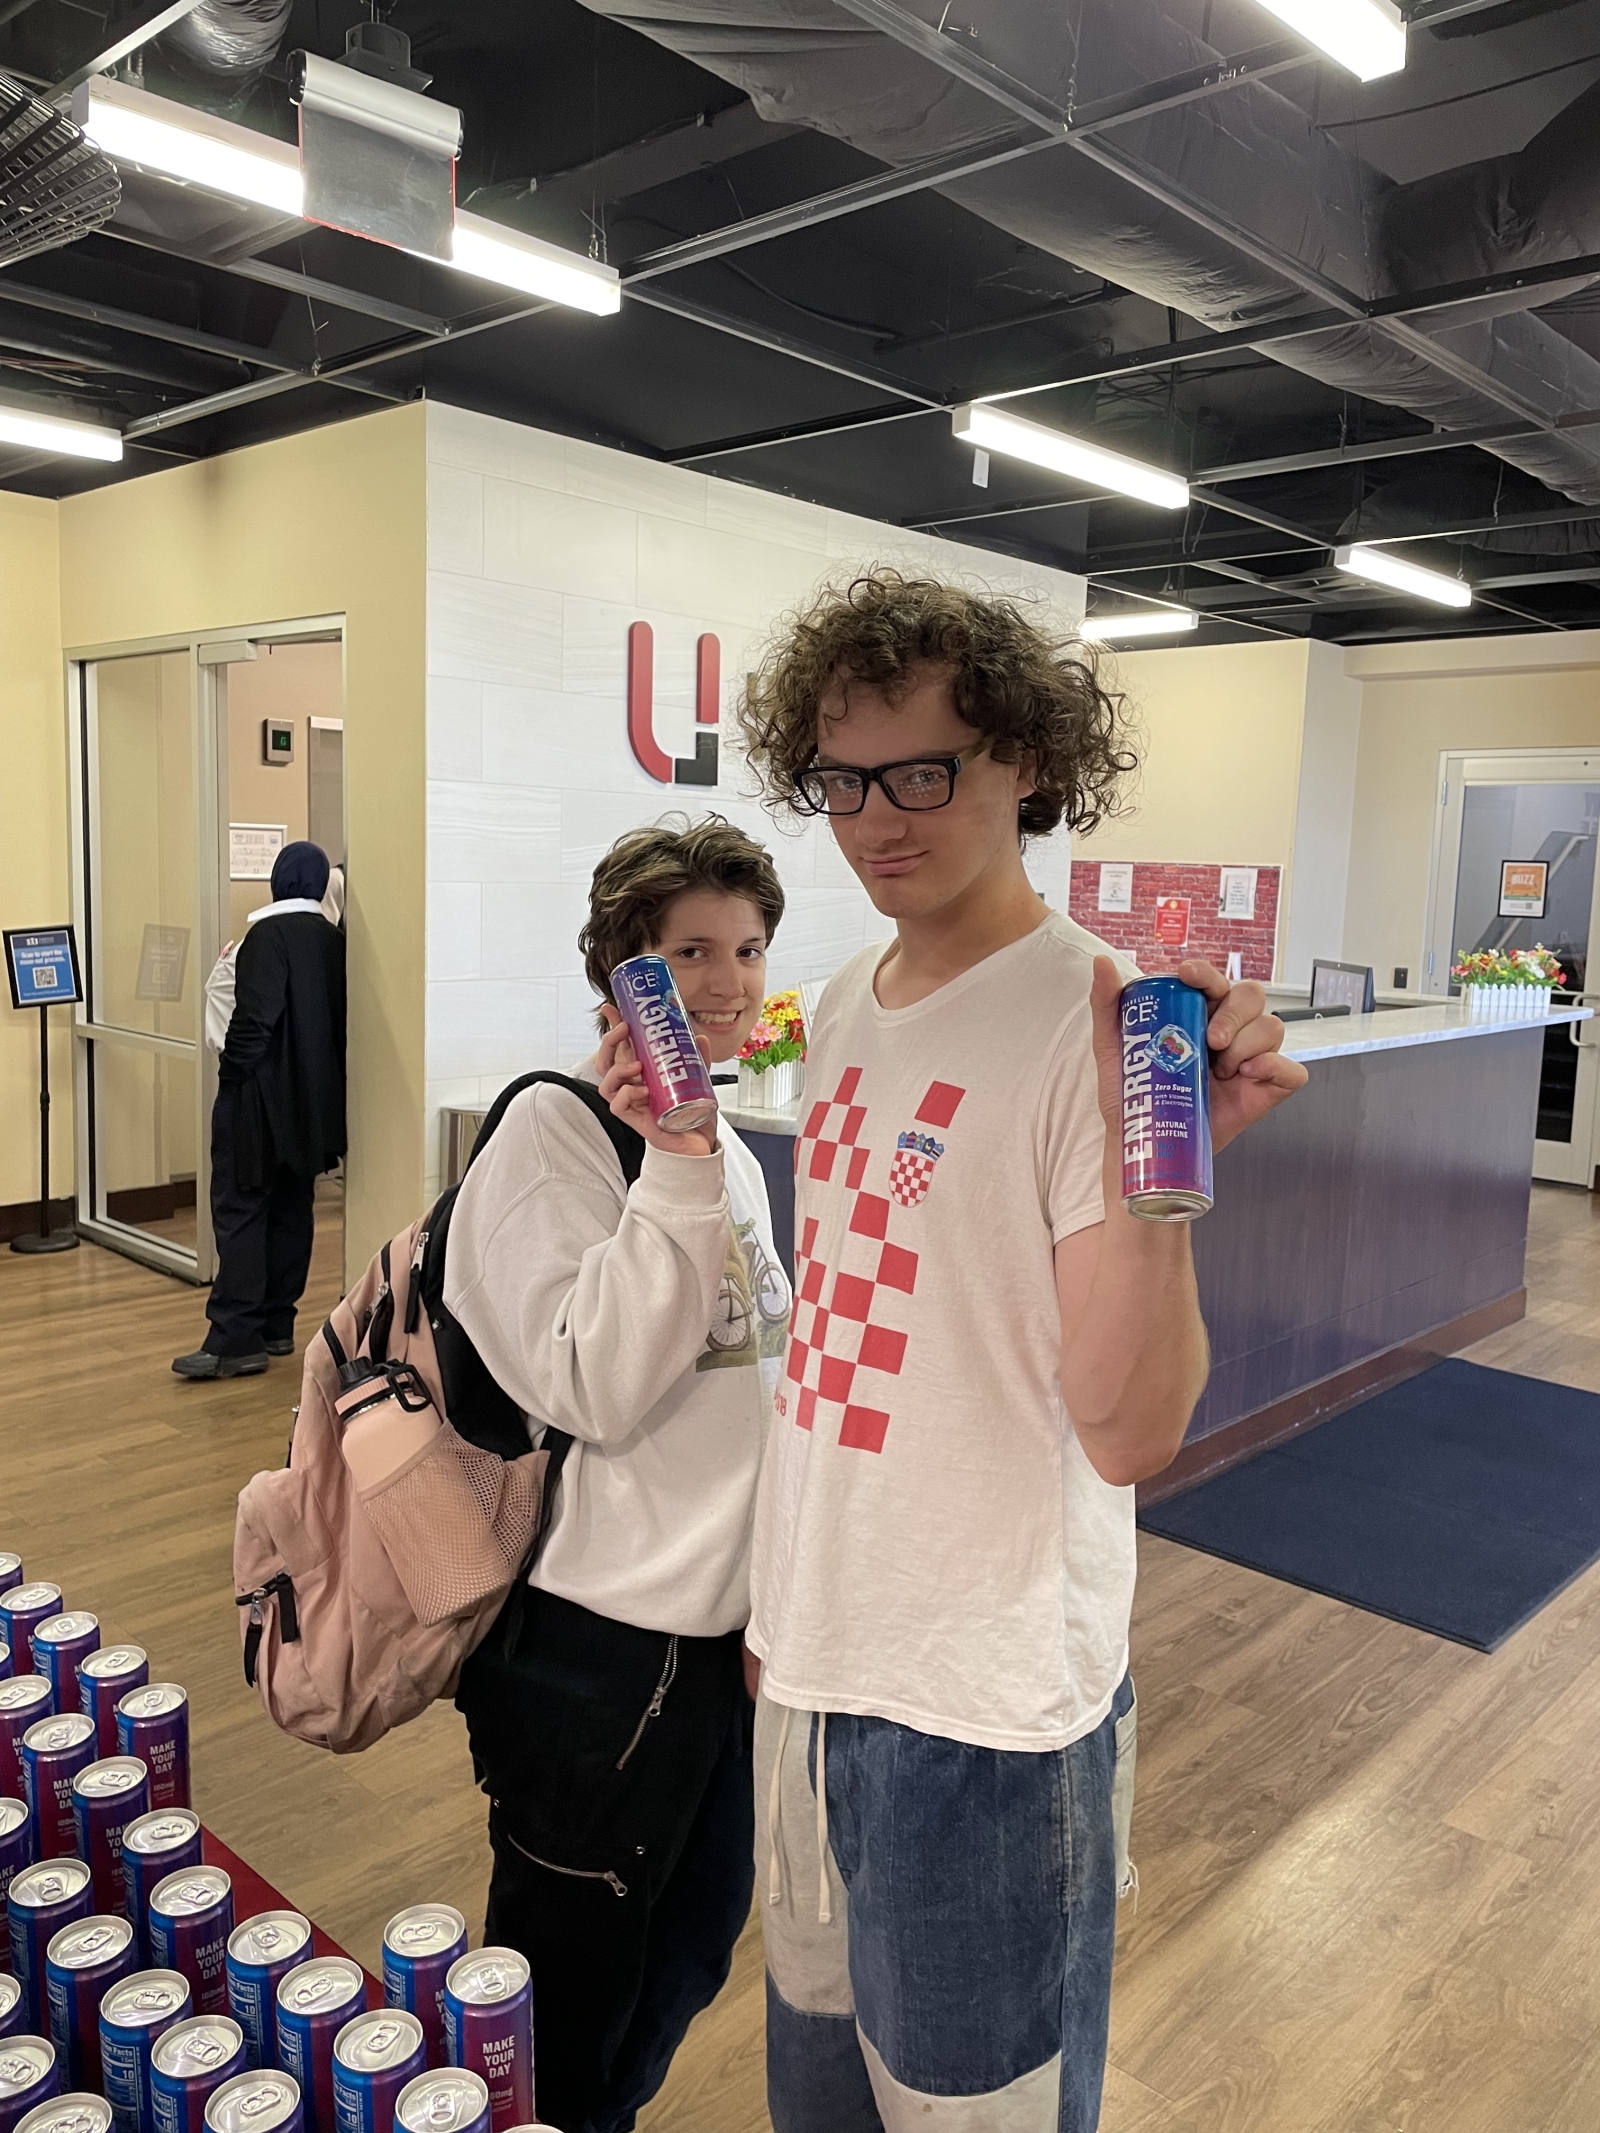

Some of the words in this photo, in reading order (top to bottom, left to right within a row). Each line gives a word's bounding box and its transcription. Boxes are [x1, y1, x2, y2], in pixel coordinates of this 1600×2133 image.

[1122, 1001, 1153, 1030] ICE
[634, 994, 688, 1088] ENERGY
[1154, 1083, 1171, 1091] Zero
[1172, 1083, 1192, 1093] Sugar
[1123, 1033, 1153, 1166] ENERGY
[1155, 1121, 1187, 1129] NATURAL
[1155, 1130, 1188, 1139] CAFFEINE
[150, 1740, 176, 1755] MAKE
[151, 1750, 176, 1765] YOUR
[155, 1761, 173, 1774] DAY
[53, 1778, 74, 1790] MAK
[59, 1799, 73, 1809] DA
[195, 1936, 225, 1959] MAKE
[198, 1949, 225, 1970] YOUR
[203, 1962, 222, 1980] DAY
[236, 1982, 254, 1993] Facts
[245, 2005, 255, 2015] 10
[482, 2035, 515, 2054] MAKE
[113, 2046, 133, 2057] Facts
[484, 2048, 515, 2067] YOUR
[288, 2053, 297, 2065] 10
[122, 2069, 135, 2080] 10
[489, 2062, 511, 2079] DAY
[162, 2118, 172, 2131] 10
[347, 2112, 357, 2124] 10
